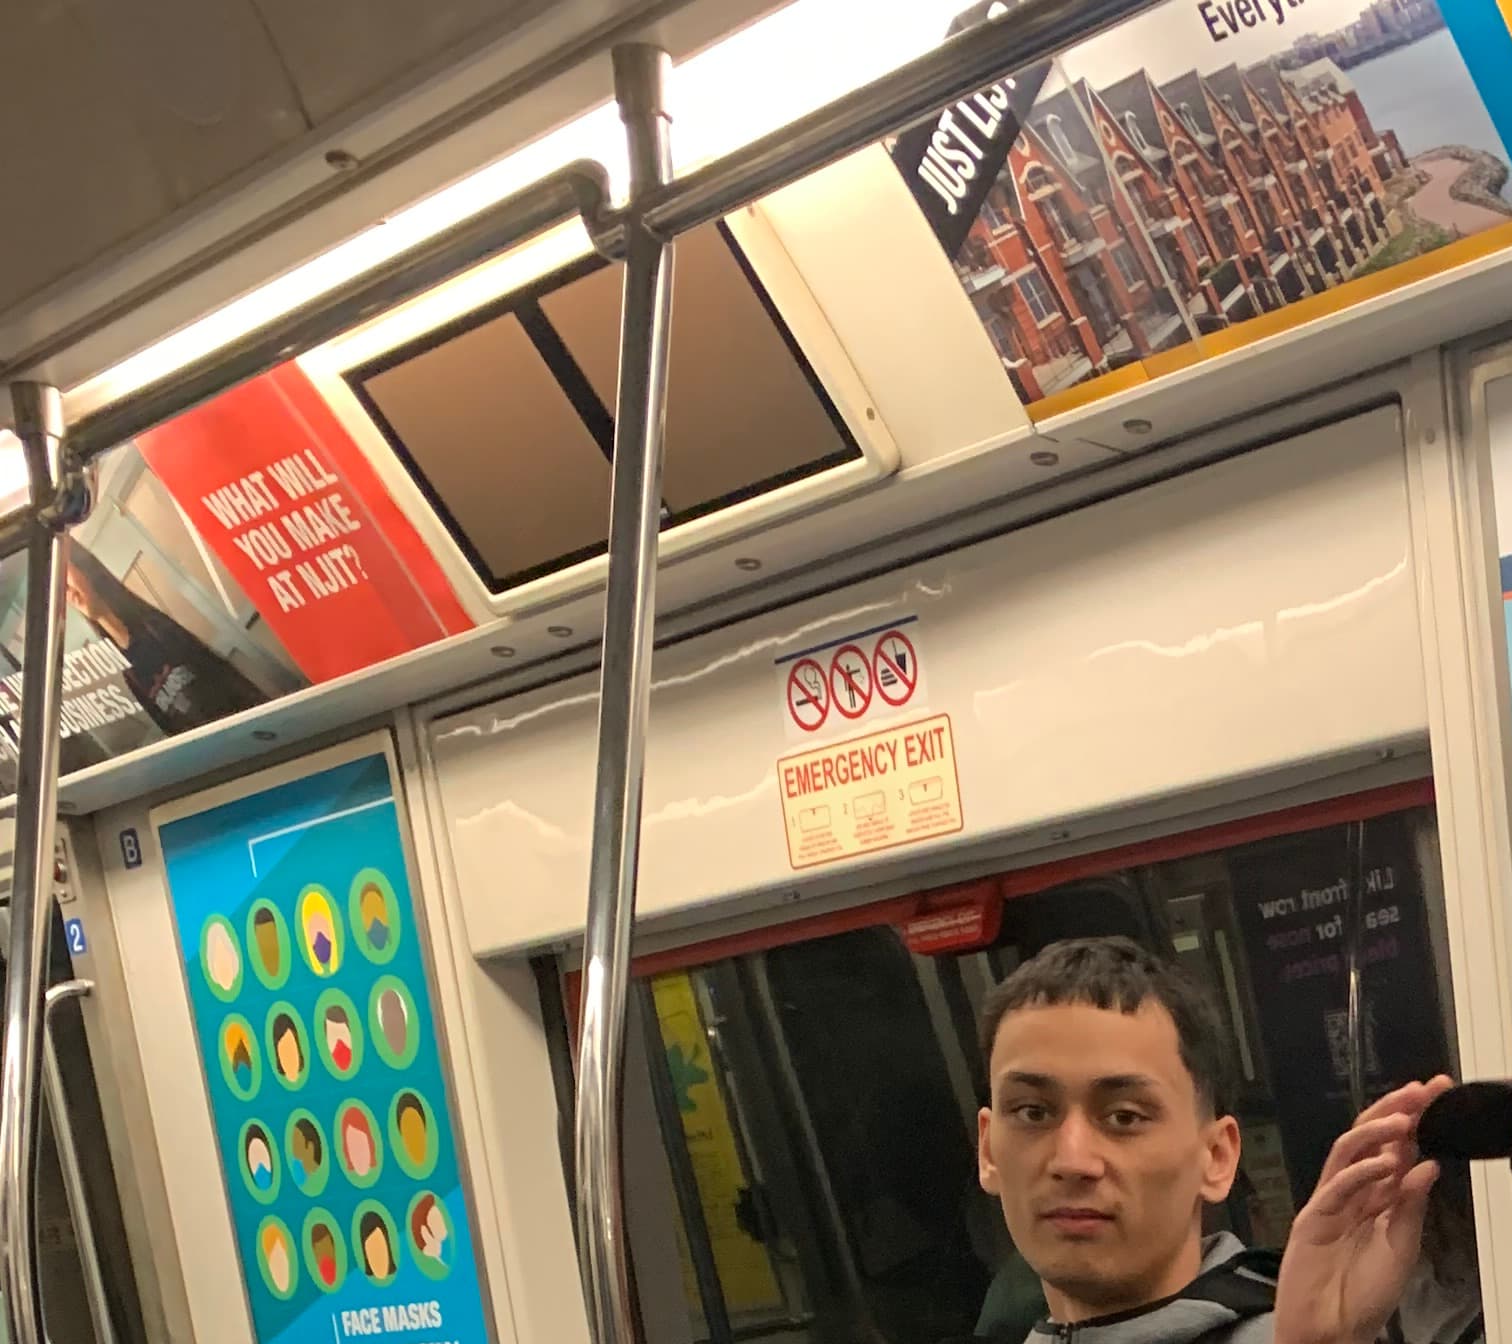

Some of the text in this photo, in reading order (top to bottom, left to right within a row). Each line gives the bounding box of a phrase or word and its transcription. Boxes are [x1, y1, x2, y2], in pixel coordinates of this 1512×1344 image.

[918, 108, 983, 215] JUST
[201, 449, 338, 530] WHAT WILL
[233, 493, 361, 570] YOU MAKE
[267, 544, 368, 613] AT NJIT?
[784, 726, 945, 798] EMERGENCY EXIT
[123, 835, 137, 863] B
[70, 923, 83, 952] 2
[341, 1300, 443, 1336] FACE MASKS
